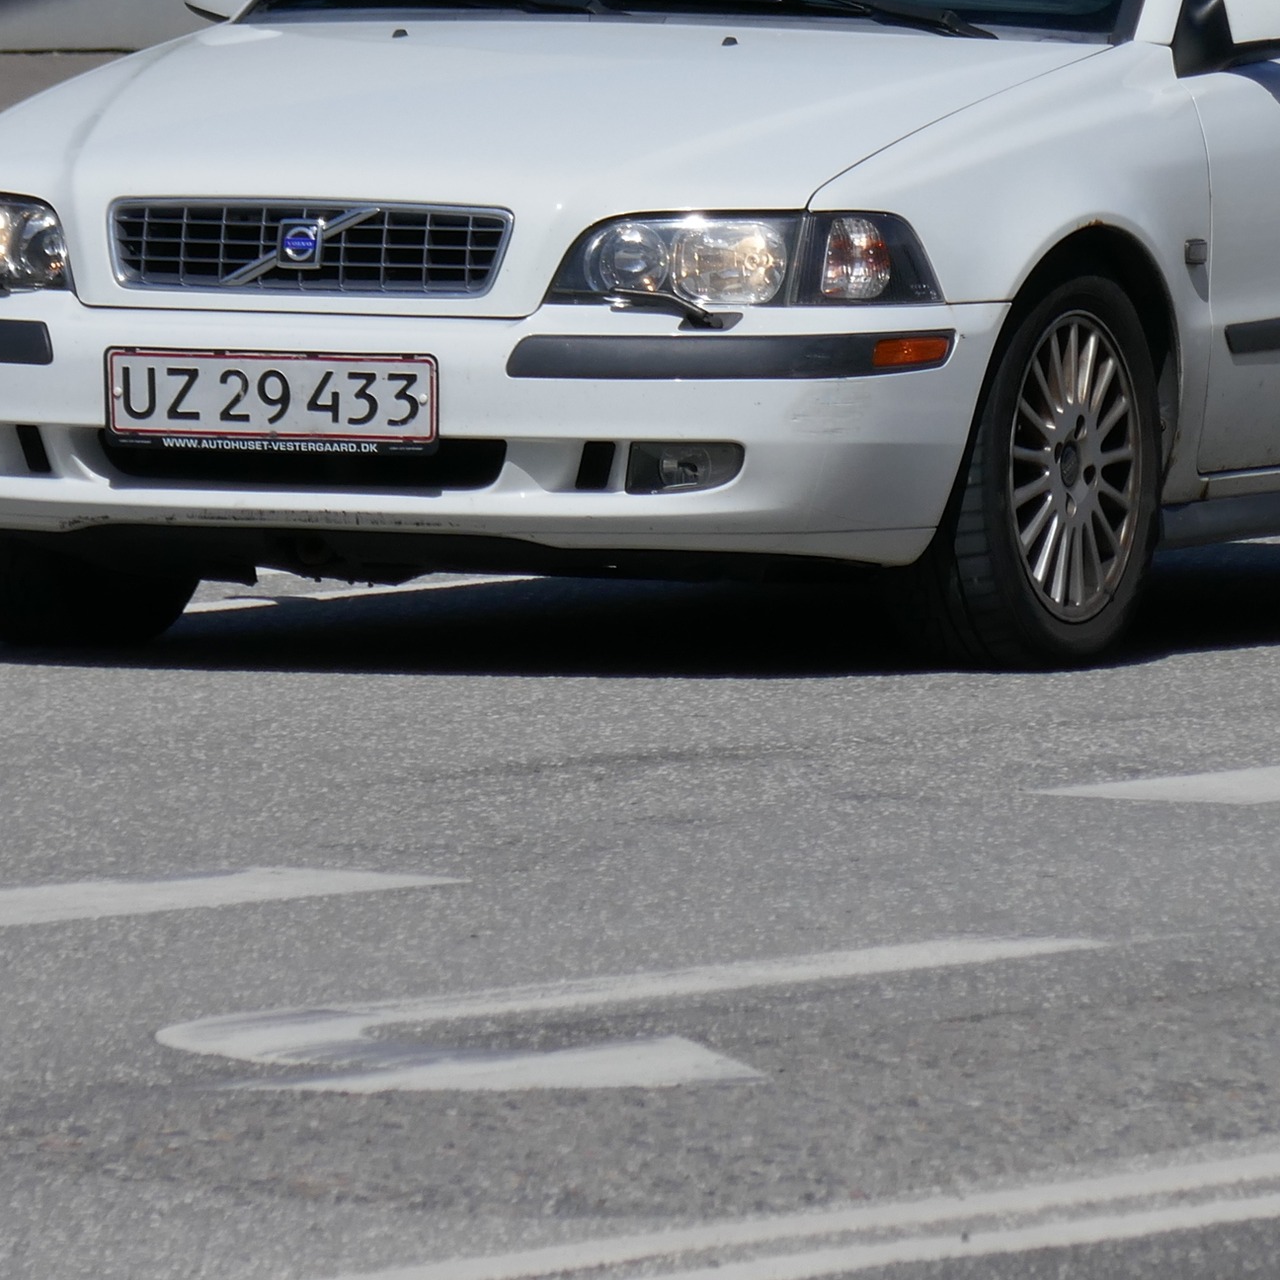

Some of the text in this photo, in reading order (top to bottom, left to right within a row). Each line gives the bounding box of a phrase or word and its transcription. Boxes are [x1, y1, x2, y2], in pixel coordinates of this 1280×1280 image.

[122, 366, 420, 427] UZ 29 433
[162, 437, 379, 453] WWW.AUTOHUSET-VESTERGAARD.DK
